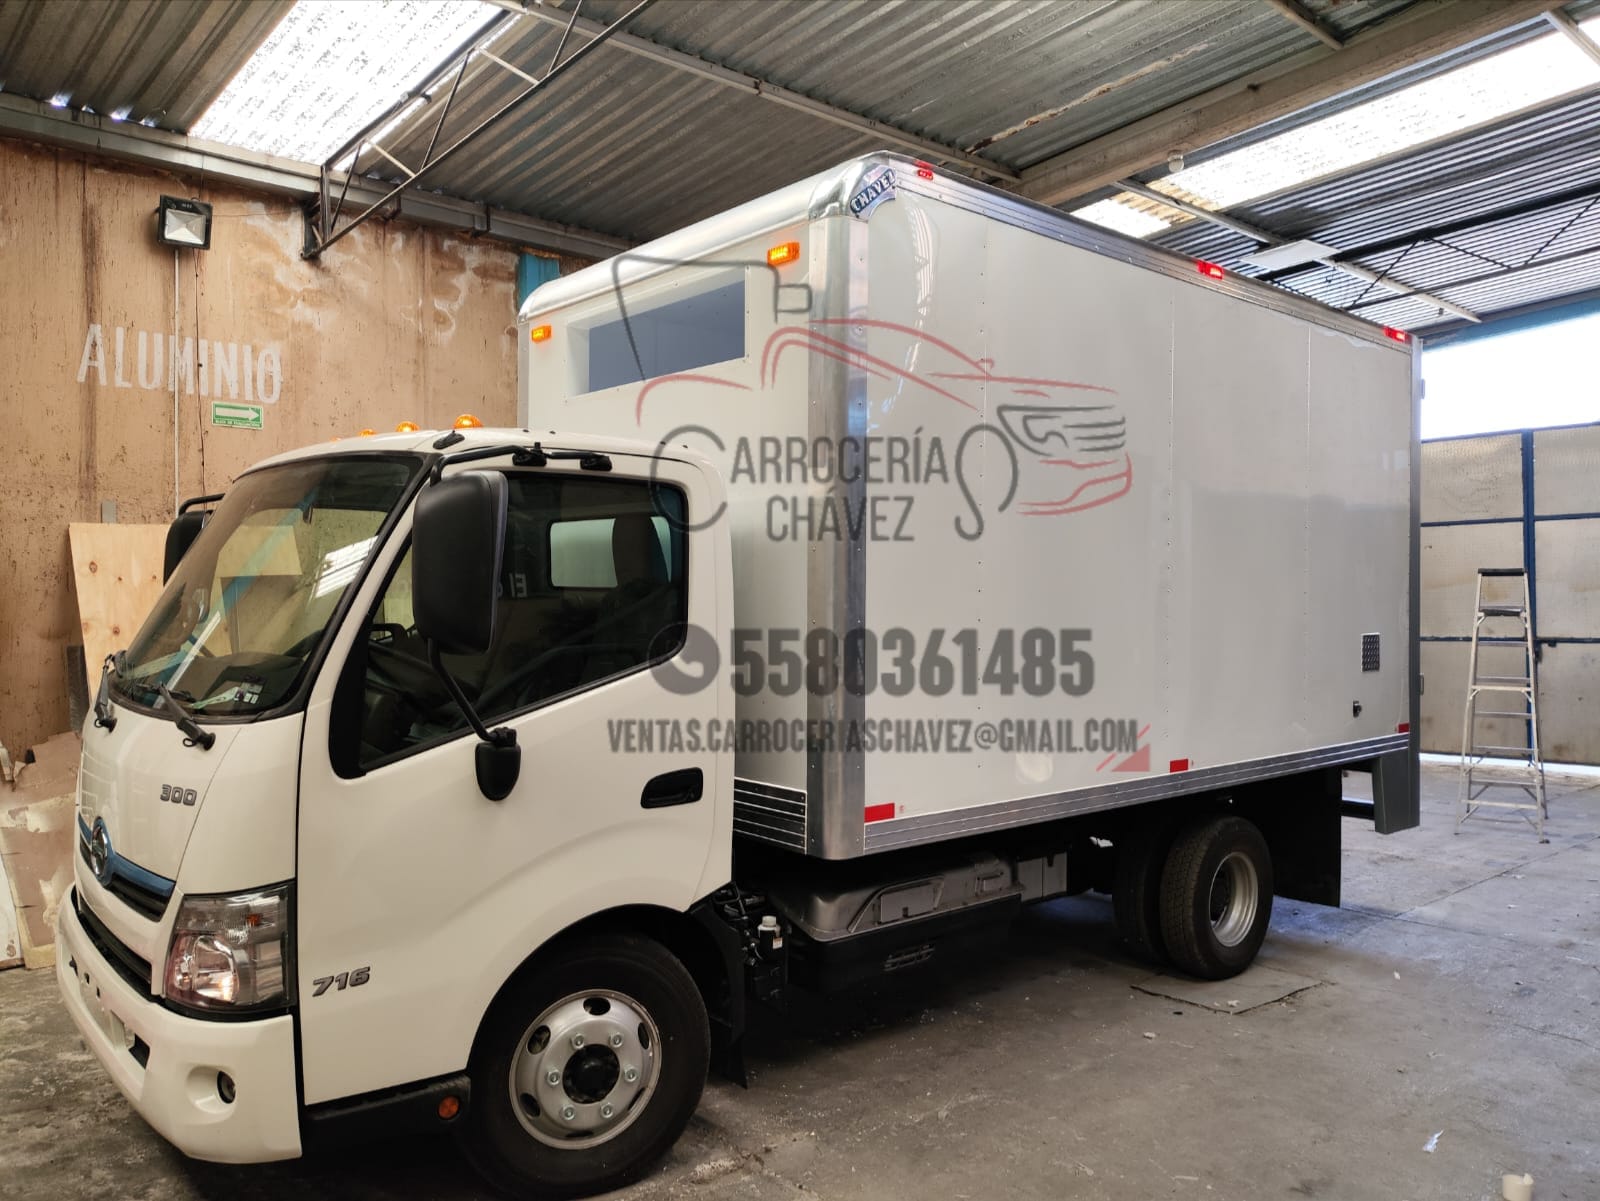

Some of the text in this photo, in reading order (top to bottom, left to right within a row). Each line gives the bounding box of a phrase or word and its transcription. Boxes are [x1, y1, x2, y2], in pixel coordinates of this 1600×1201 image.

[77, 324, 282, 404] ALUMINIO
[160, 784, 197, 806] 300
[312, 966, 371, 997] 716
